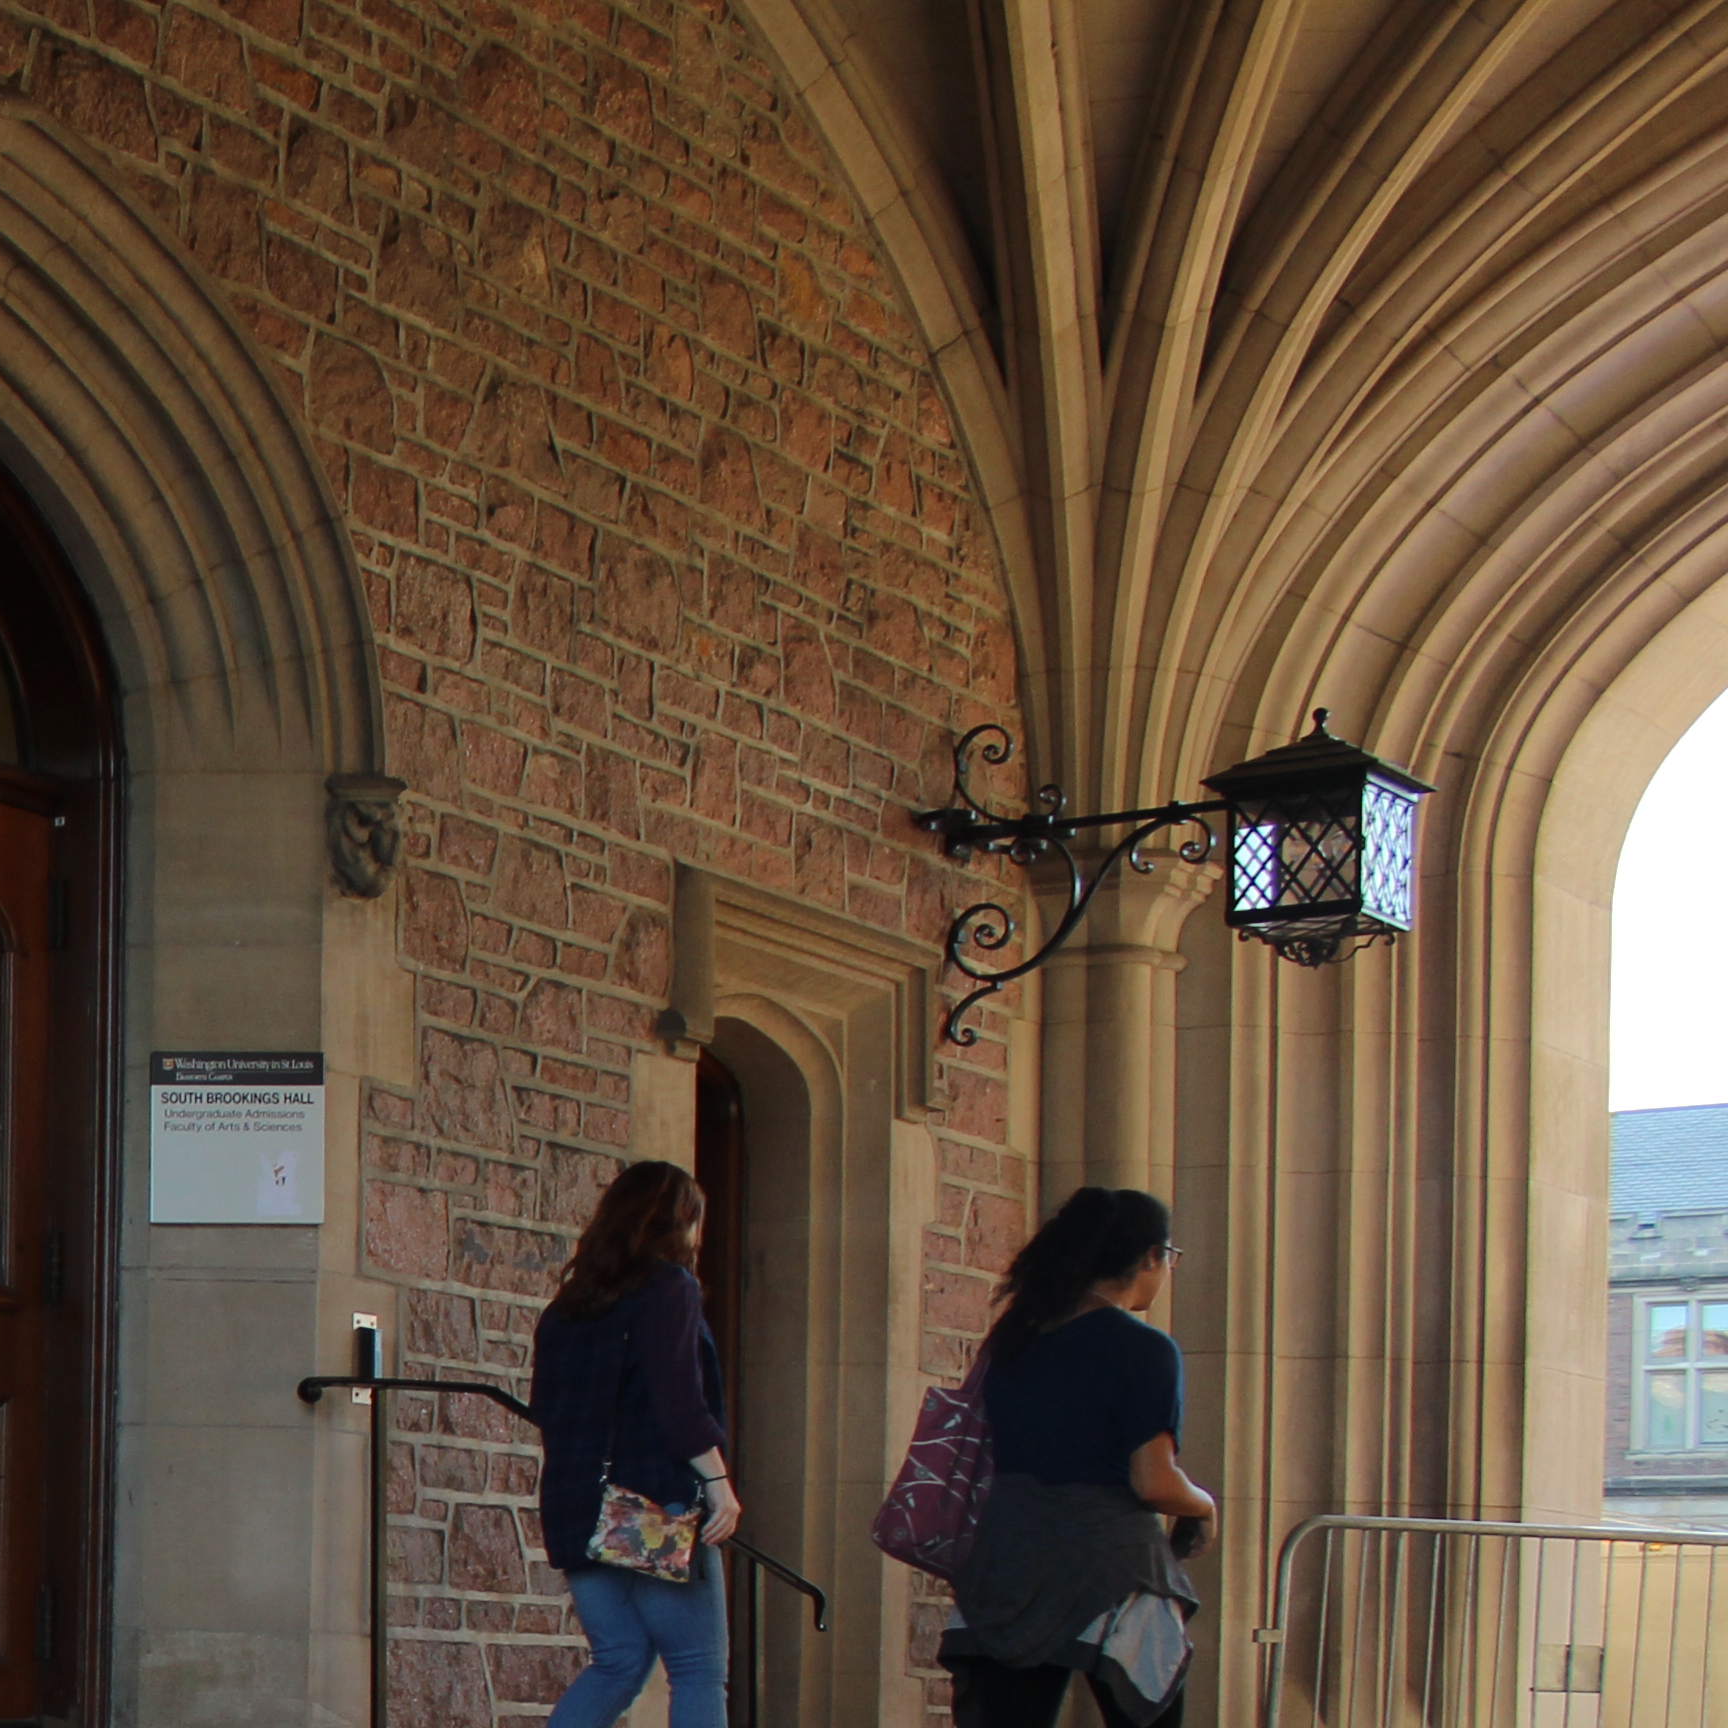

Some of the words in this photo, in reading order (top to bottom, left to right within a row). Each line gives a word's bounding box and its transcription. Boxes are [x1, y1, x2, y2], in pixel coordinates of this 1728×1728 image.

[174, 1058, 226, 1071] Washington
[227, 1059, 270, 1072] University
[272, 1059, 280, 1070] in
[291, 1060, 314, 1070] Louis
[161, 1092, 203, 1105] SOUTH
[206, 1092, 280, 1105] BROOKINGS
[283, 1092, 314, 1105] HALL
[164, 1109, 243, 1121] Undergraduate
[245, 1109, 305, 1119] Admissions
[164, 1122, 202, 1133] Faculty
[204, 1122, 216, 1131] of
[218, 1122, 240, 1131] Arts
[242, 1122, 250, 1131] &
[253, 1122, 302, 1131] Sciences
